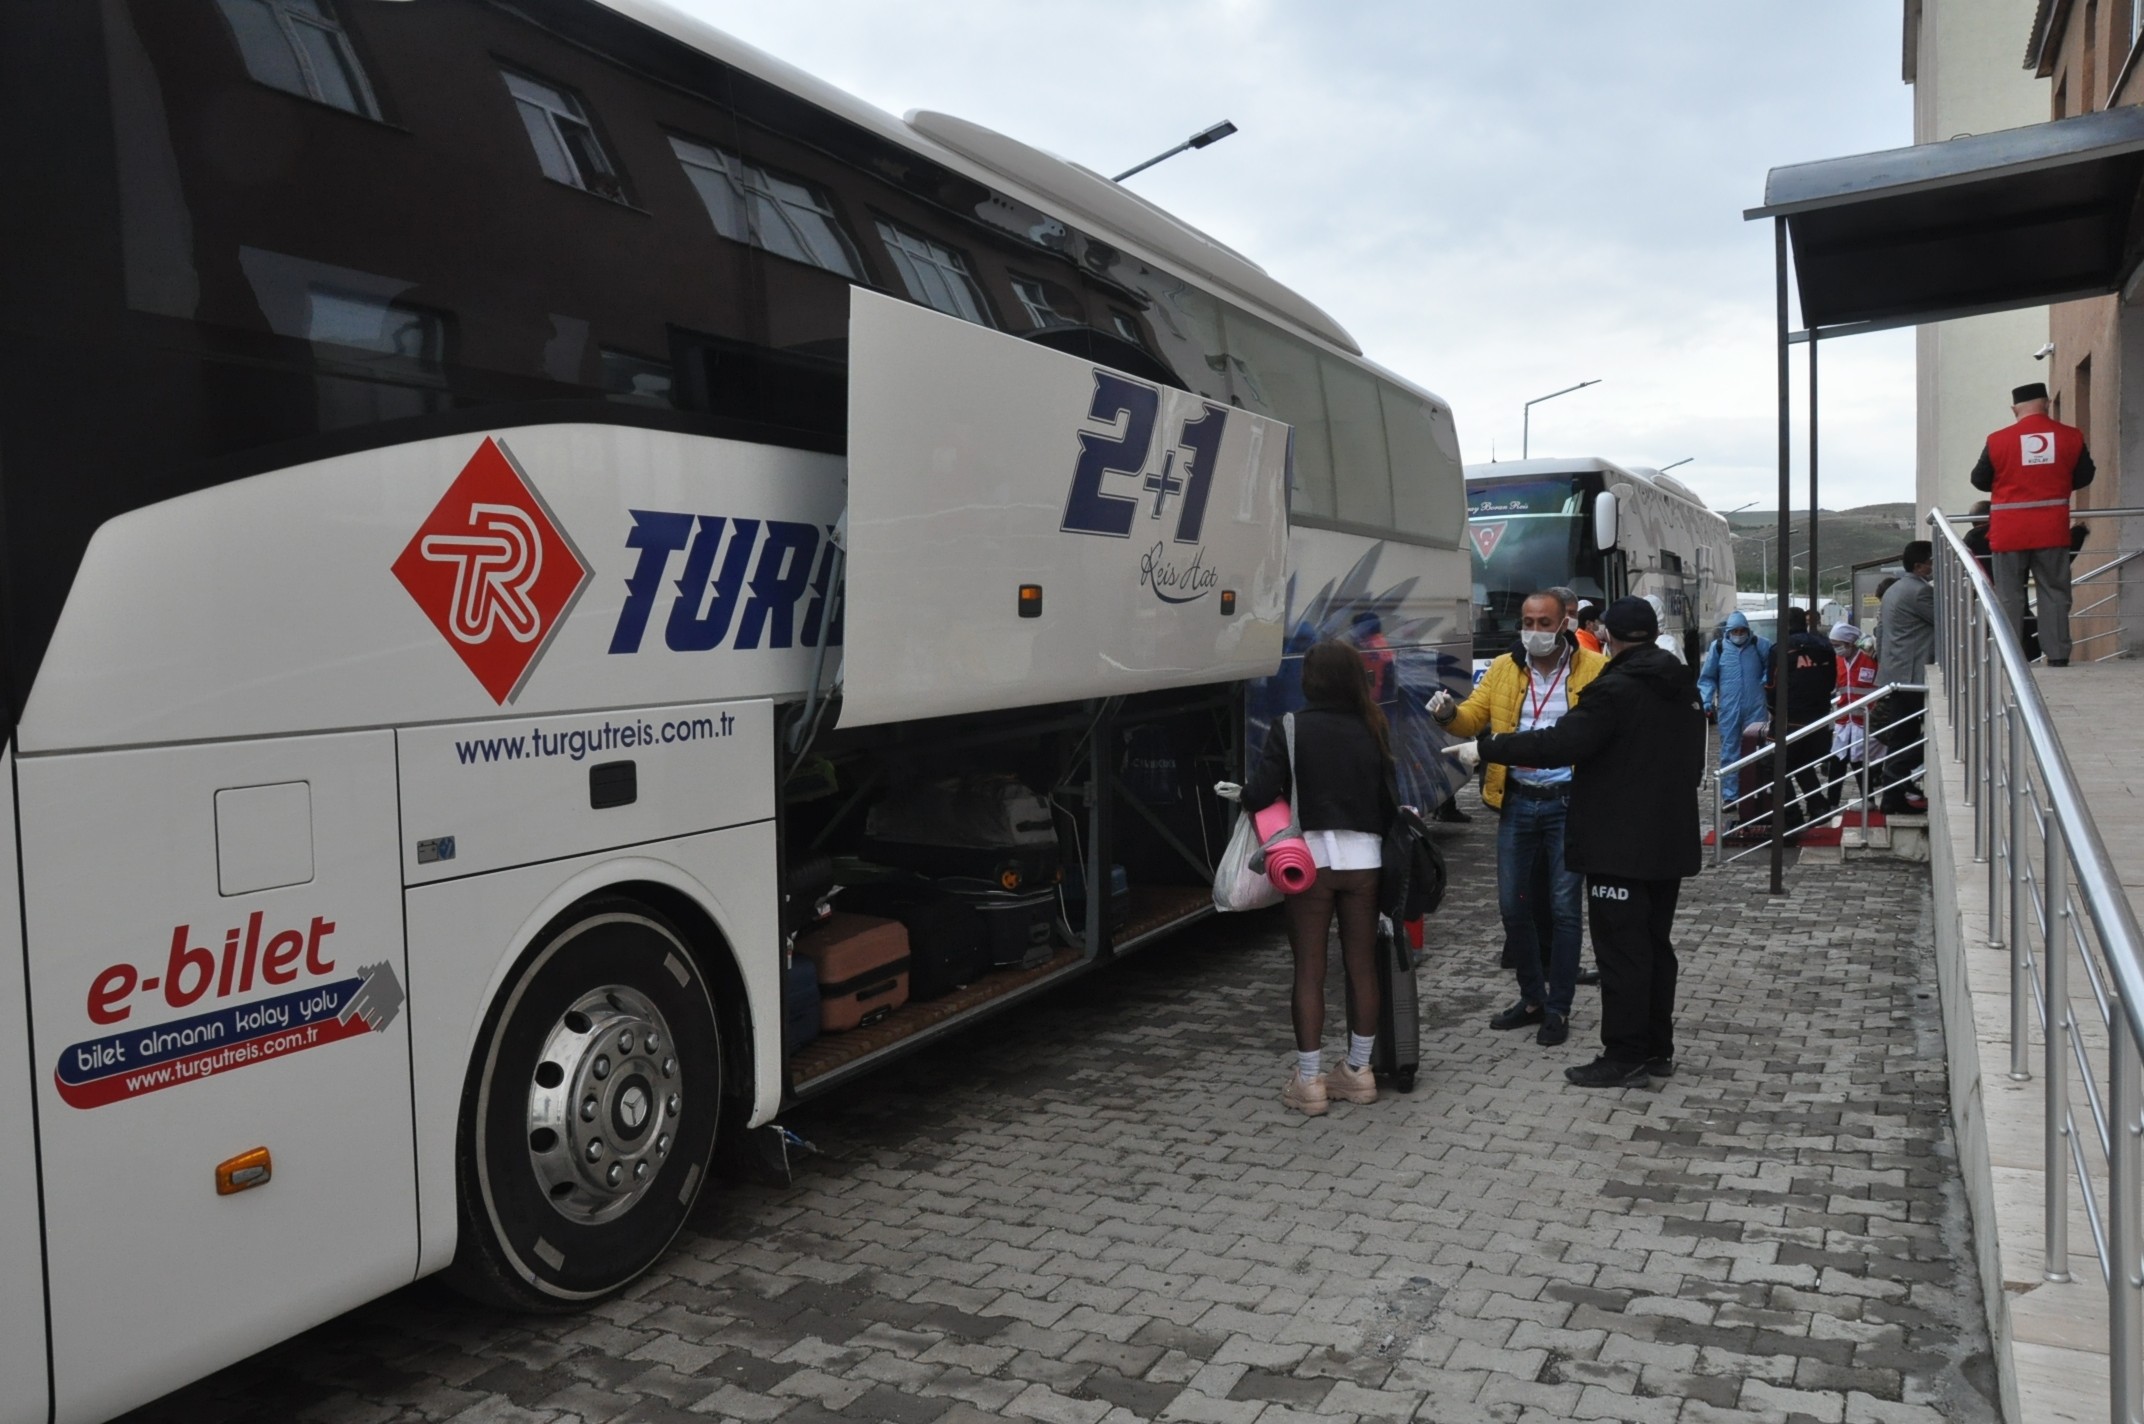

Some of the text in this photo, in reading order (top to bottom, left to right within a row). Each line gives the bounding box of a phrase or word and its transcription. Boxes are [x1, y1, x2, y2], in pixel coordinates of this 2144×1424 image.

[1059, 366, 1229, 545] 2+1
[456, 711, 735, 765] www.turgutreis.com.tr
[1591, 885, 1629, 900] AFAD
[87, 911, 336, 1025] e-bilet
[78, 990, 338, 1071] bilet almanın kolay yolu
[126, 1025, 319, 1092] www.turgutreis.com.tr
